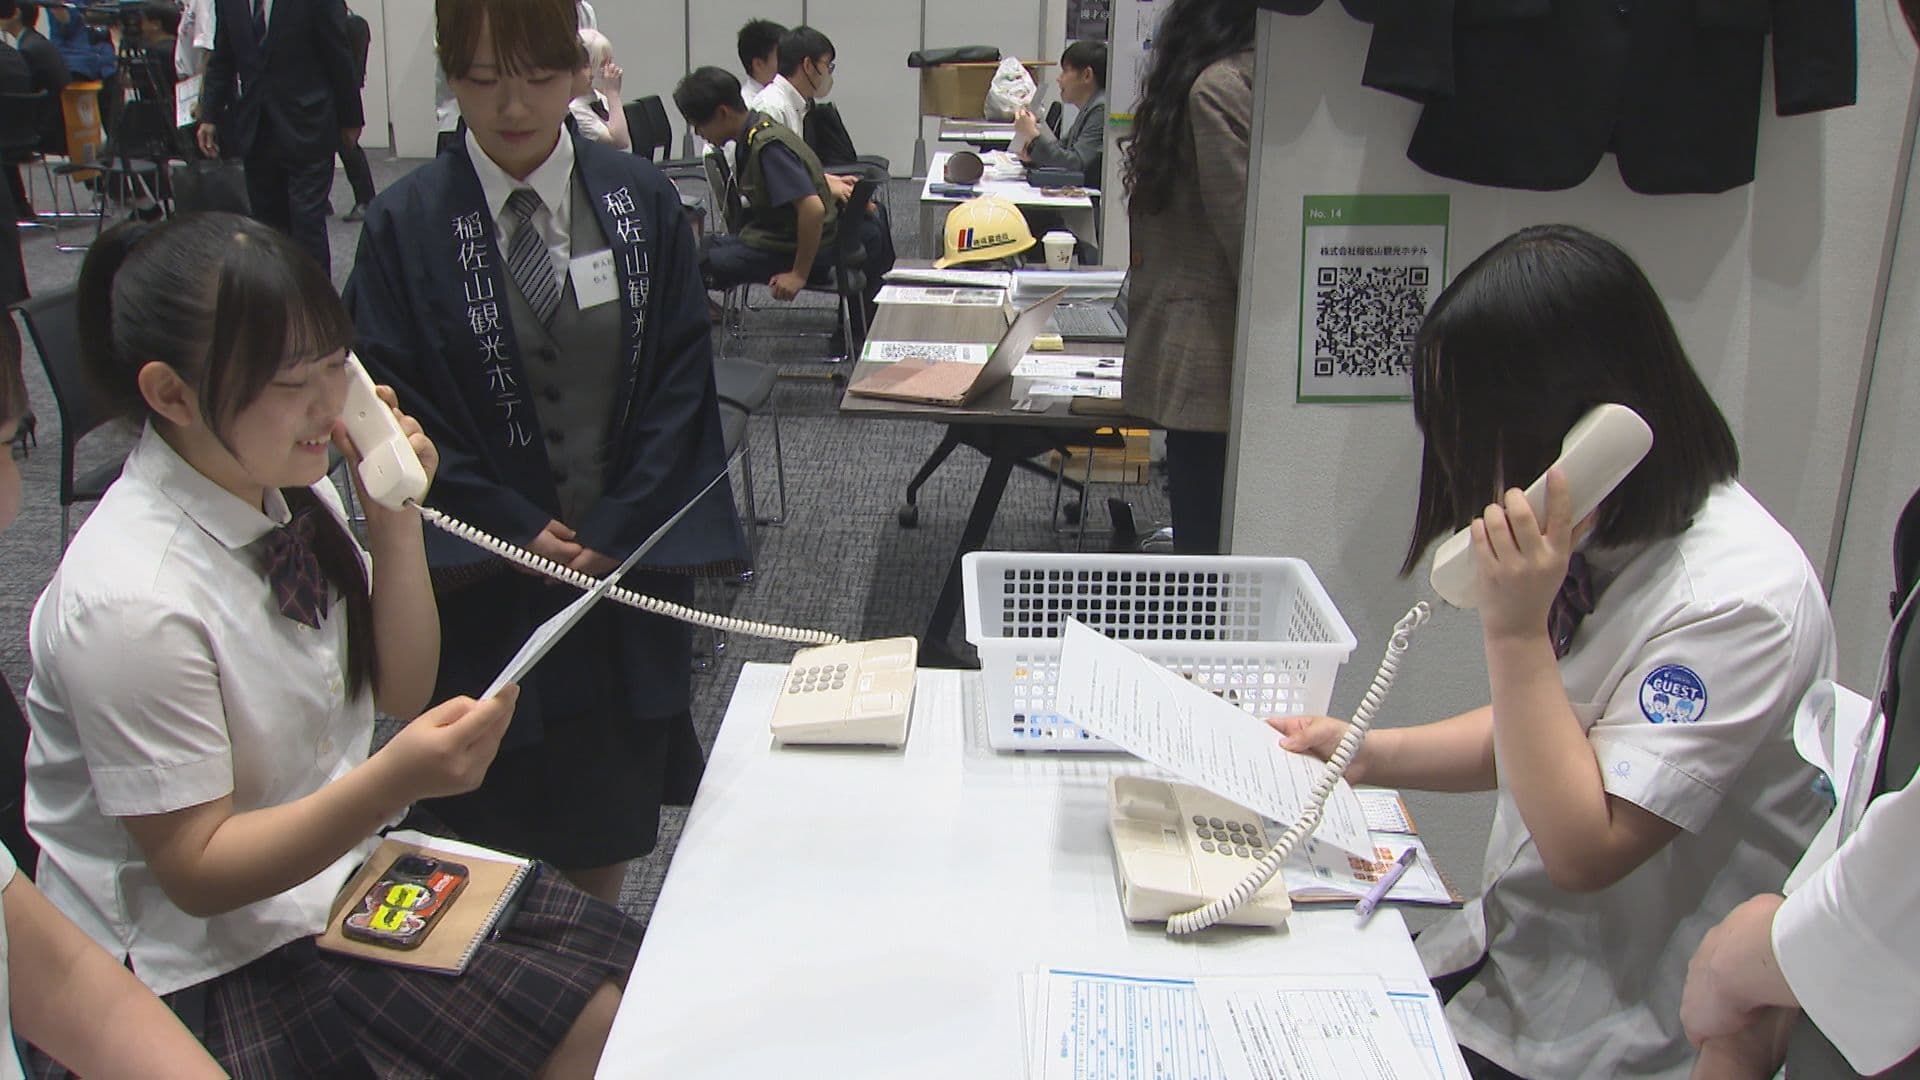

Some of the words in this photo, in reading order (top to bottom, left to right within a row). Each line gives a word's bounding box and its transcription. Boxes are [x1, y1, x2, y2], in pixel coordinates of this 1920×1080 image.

[1309, 208, 1326, 219] No.
[1331, 208, 1342, 219] 14
[451, 211, 532, 448] 稲佐山観光ホテル
[602, 186, 648, 424] 稲佐山観光
[1653, 678, 1699, 701] GUEST
